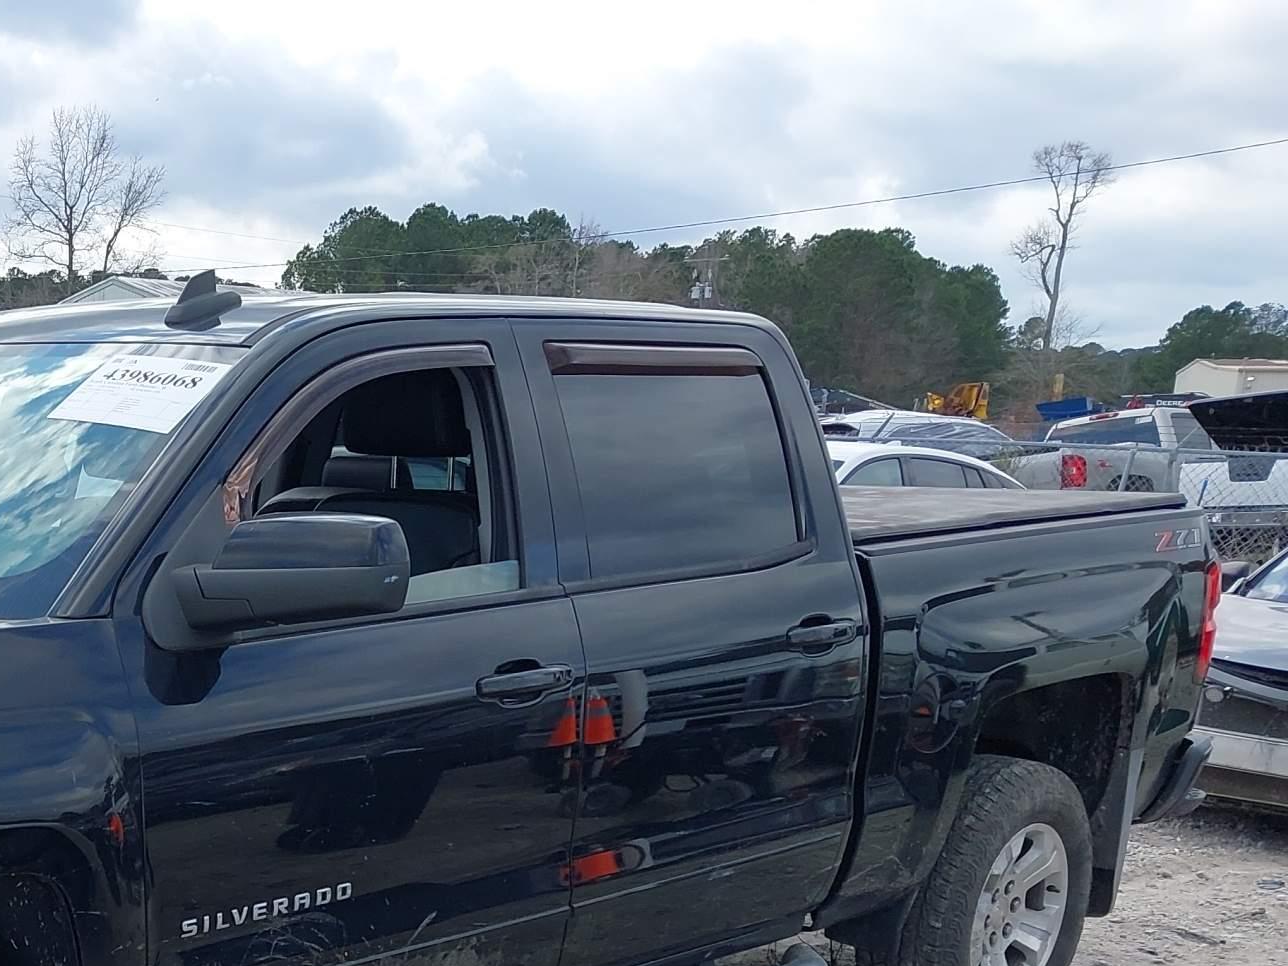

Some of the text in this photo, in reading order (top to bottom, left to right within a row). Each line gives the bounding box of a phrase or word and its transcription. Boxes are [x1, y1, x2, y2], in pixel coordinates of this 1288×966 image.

[103, 368, 203, 390] 43986068
[1154, 528, 1201, 552] Z71
[180, 882, 353, 938] SILVERADO
